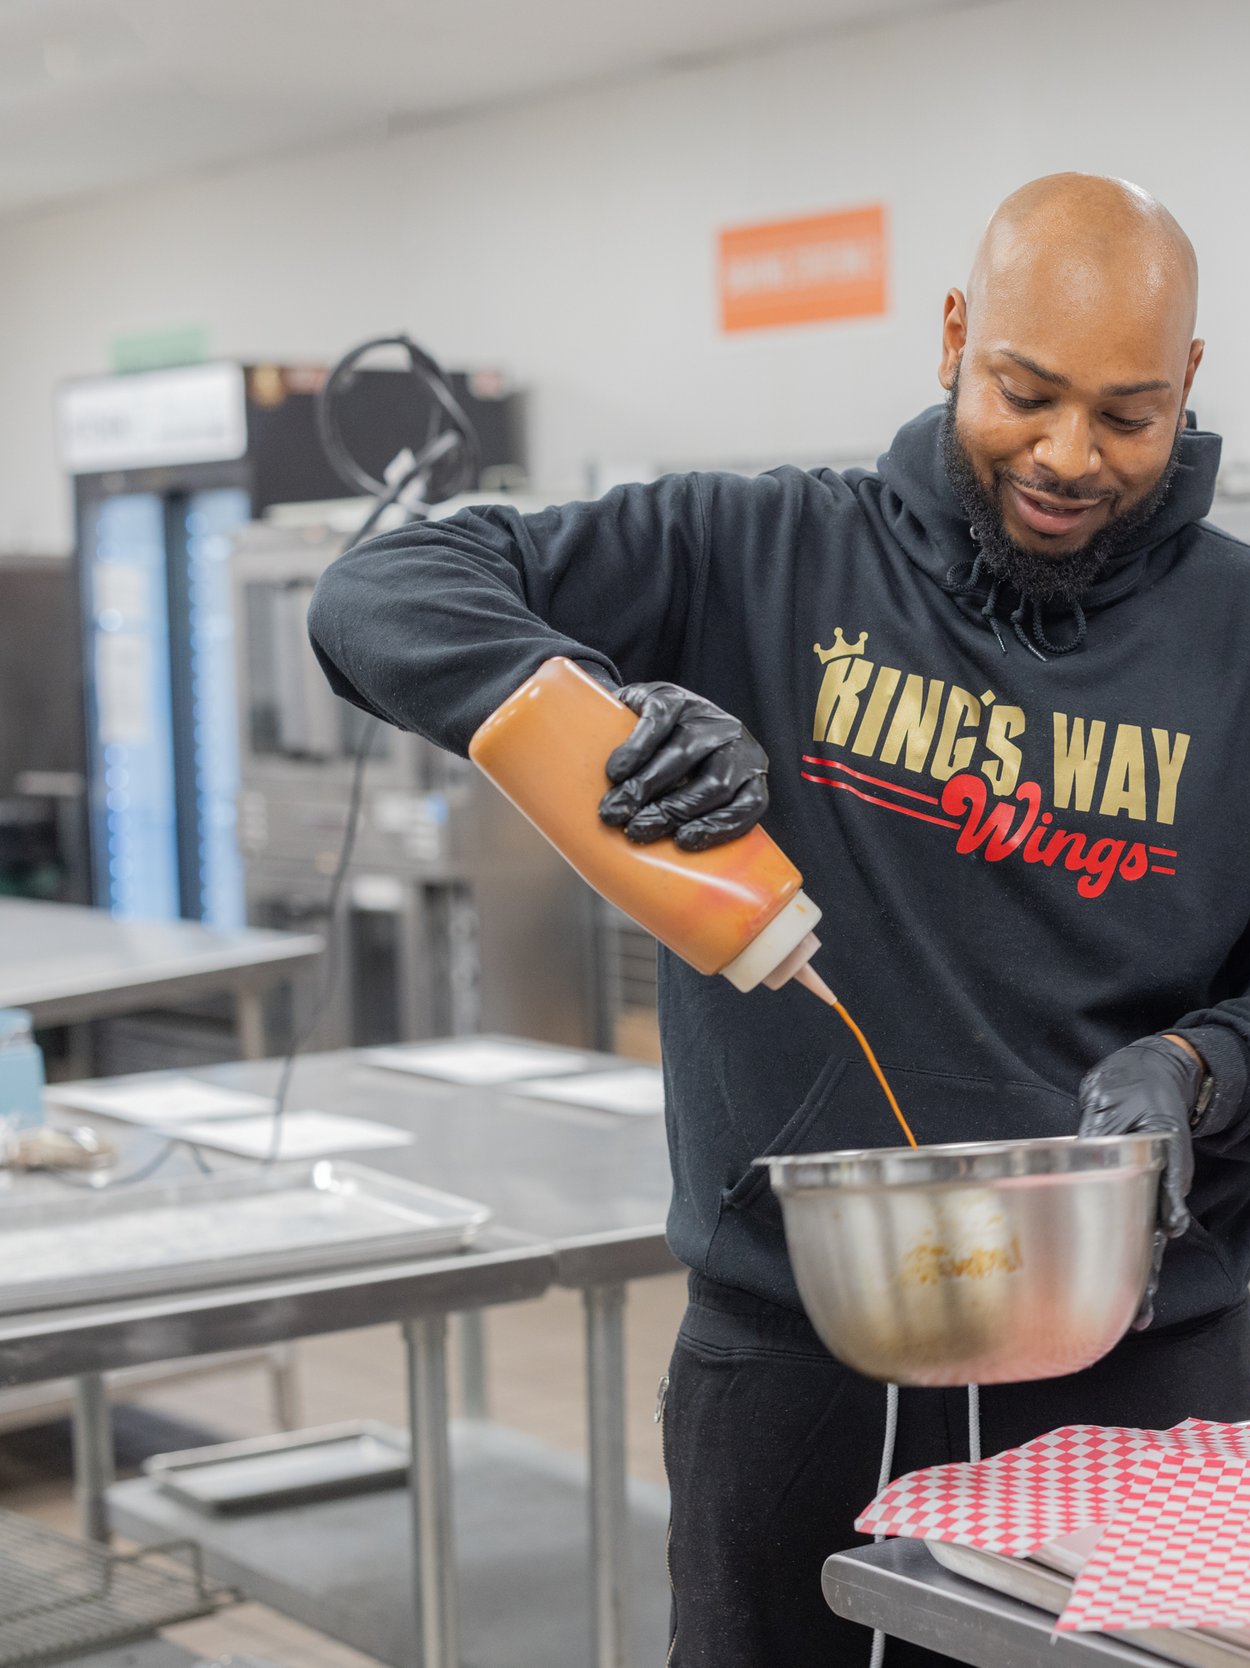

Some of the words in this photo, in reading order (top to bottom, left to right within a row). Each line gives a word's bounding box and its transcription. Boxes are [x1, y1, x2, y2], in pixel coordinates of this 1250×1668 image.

[812, 657, 1026, 797] KING'S
[1053, 711, 1191, 825] WAY
[941, 773, 1149, 899] Wings
